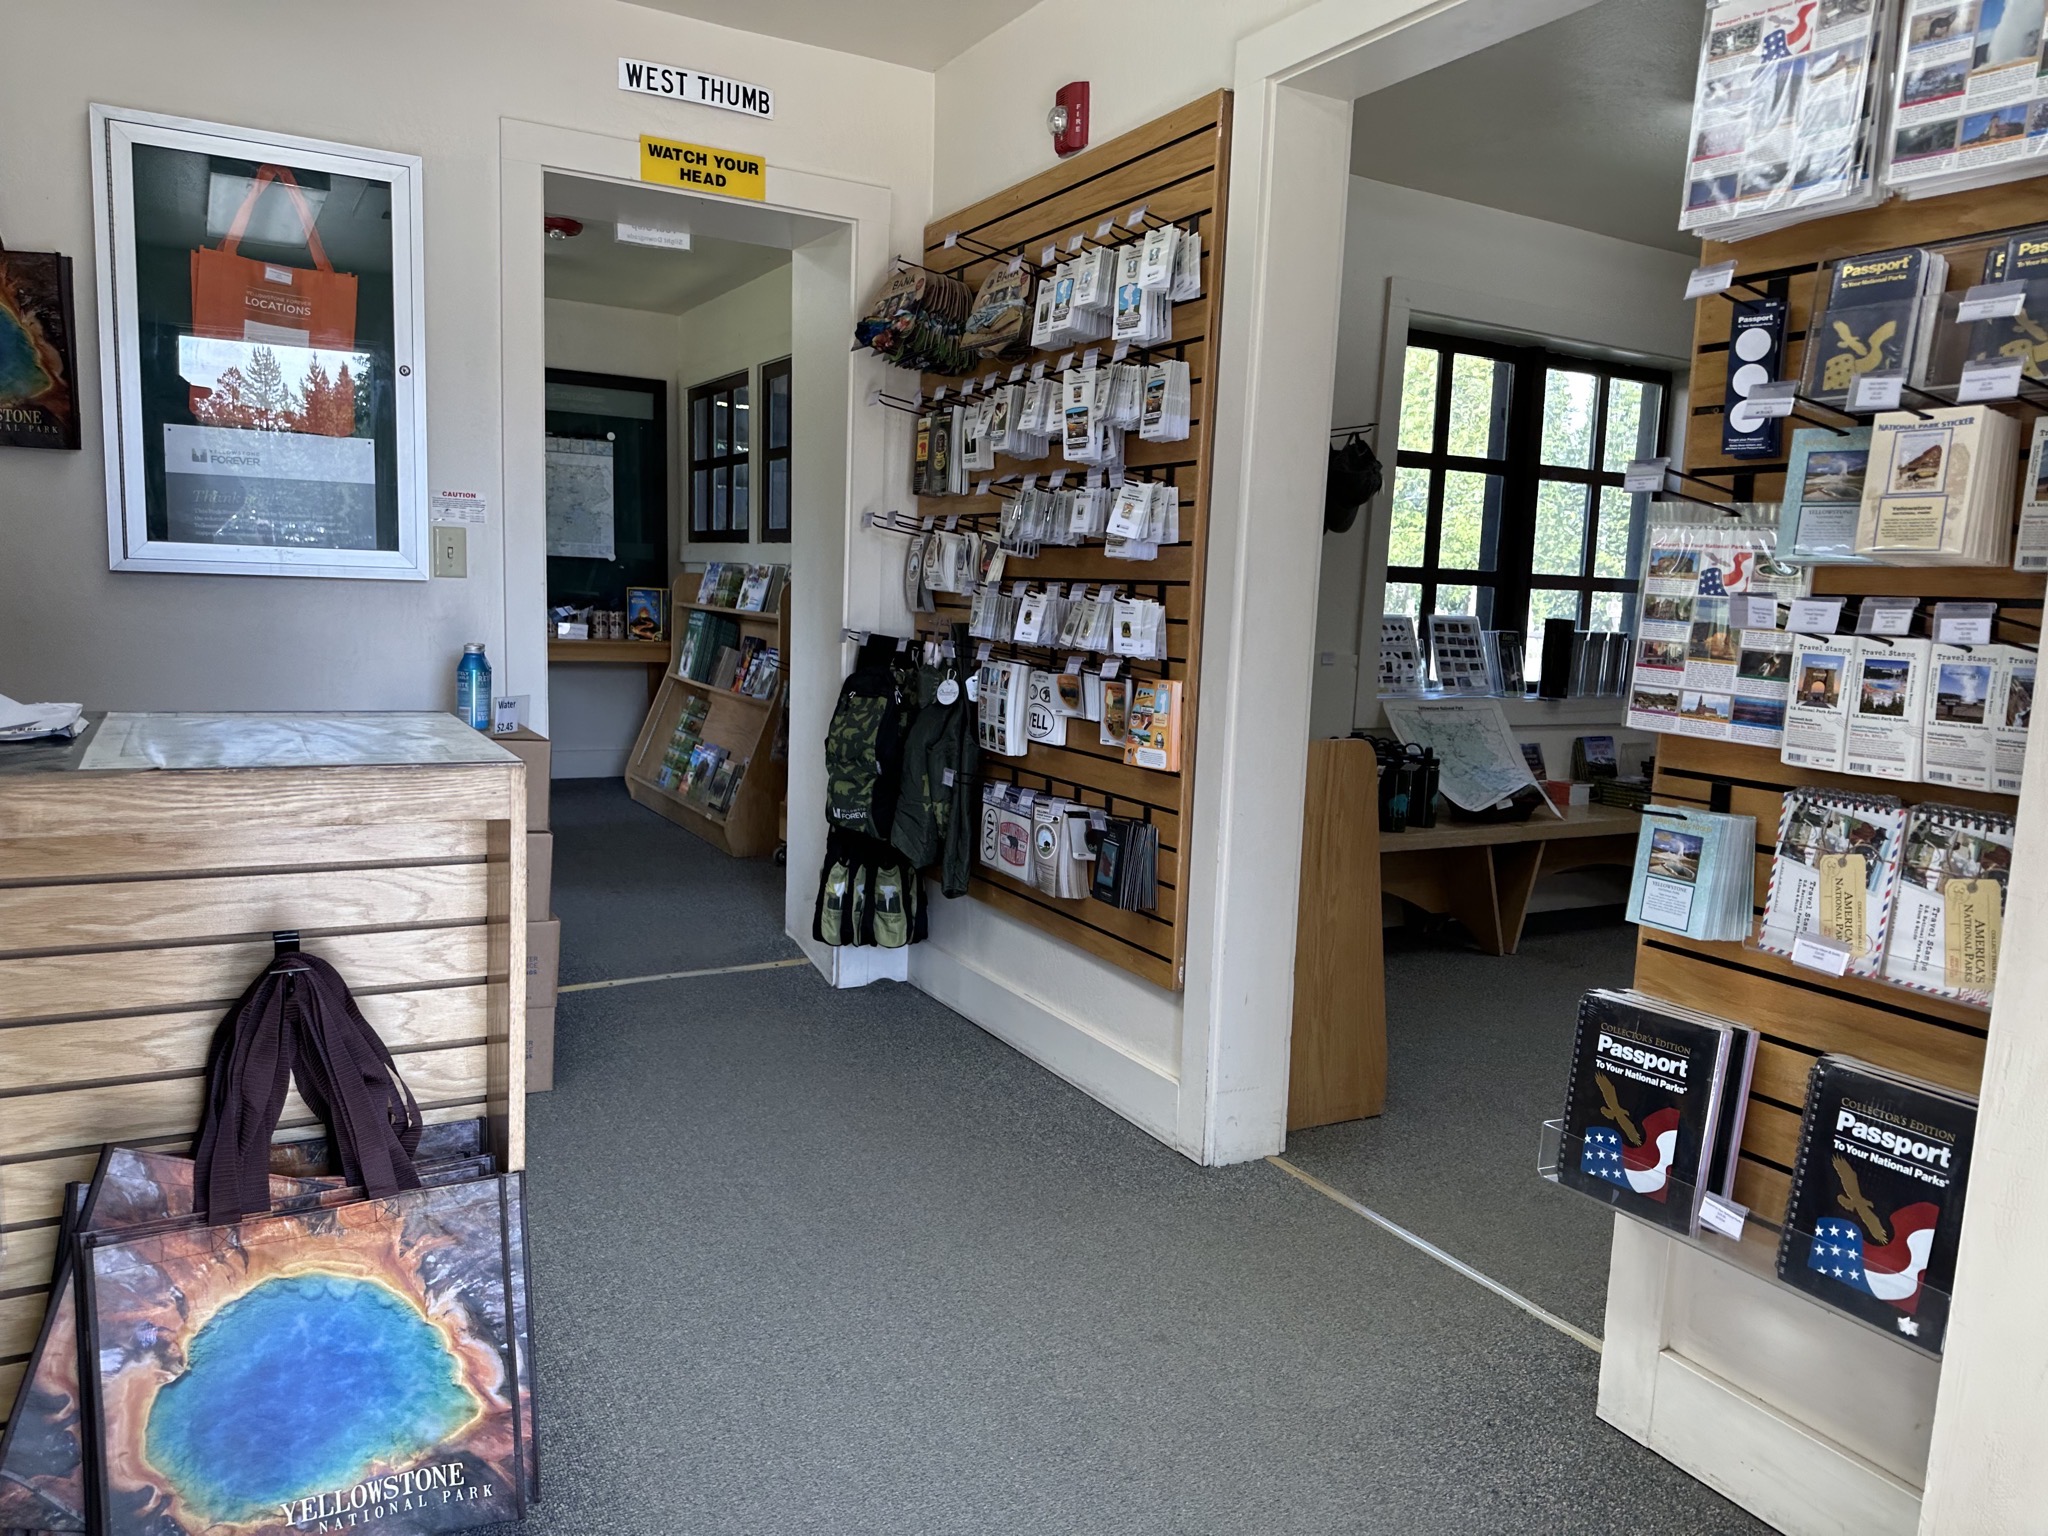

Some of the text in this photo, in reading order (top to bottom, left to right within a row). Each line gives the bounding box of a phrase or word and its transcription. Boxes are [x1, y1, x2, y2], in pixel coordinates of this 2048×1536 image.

[626, 62, 770, 114] WEST THUMB
[648, 143, 759, 176] WATCH YOUR
[680, 168, 726, 188] HEAD
[1842, 254, 1910, 278] Passport
[245, 296, 311, 316] LOCATIONS
[246, 290, 312, 306] YELLOWSTONE FOREVER
[1738, 314, 1774, 324] Passport
[28, 425, 58, 434] PARK
[1941, 416, 1975, 428] STICKER
[210, 455, 260, 466] FOREVER
[442, 490, 476, 498] CAUTION
[1799, 644, 1852, 655] Travel Stamps
[1862, 648, 1916, 660] Travel Stamps
[1936, 654, 1998, 665] Travel Stamps
[2008, 656, 2038, 664] Travel
[498, 700, 516, 710] Water
[496, 722, 514, 732] $2.45
[1028, 712, 1048, 730] YELL
[1652, 880, 1687, 893] YELLOWSTONE
[1802, 881, 1816, 933] Travel Stam
[1835, 878, 1844, 941] NATIONAL PAR
[1920, 907, 1940, 972] Travel Stamps
[1964, 904, 1974, 984] NATIONAL PARKS
[1974, 919, 1986, 984] AMERICA'S
[1600, 1022, 1692, 1055] COLLECTOR'S EDITION
[1597, 1034, 1688, 1078] Passport
[1596, 1058, 1605, 1069] To
[1605, 1062, 1624, 1076] Your
[1624, 1068, 1660, 1087] National
[1841, 1097, 1956, 1142] COLLECTOR'S EDITION
[1836, 1110, 1952, 1169] Passport
[1833, 1138, 1846, 1152] To
[1846, 1144, 1869, 1160] Your
[1870, 1152, 1913, 1176] National
[280, 1462, 465, 1528] YELLOWSTONE
[319, 1484, 494, 1535] NATIONAL PARK
